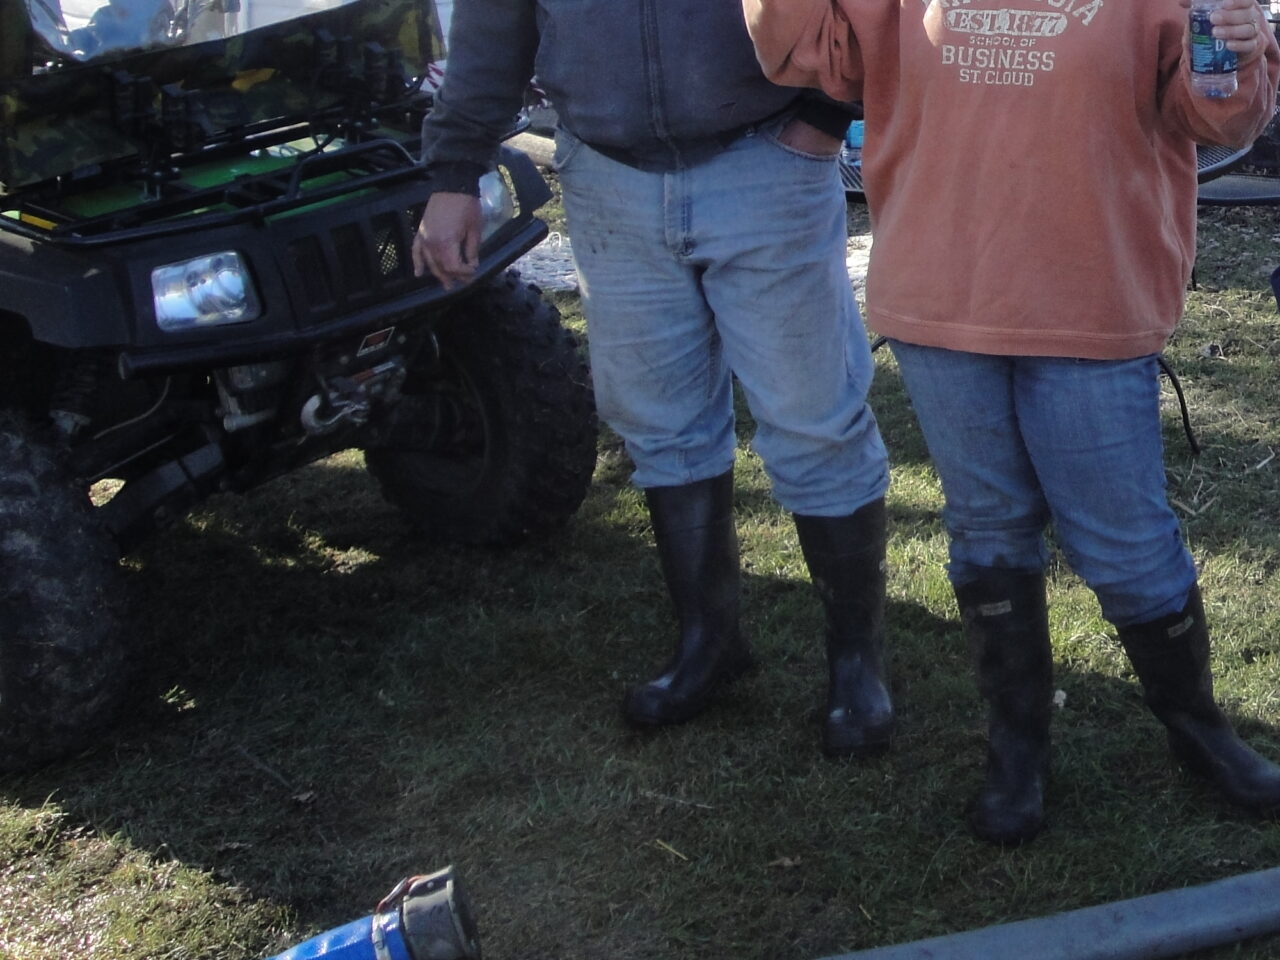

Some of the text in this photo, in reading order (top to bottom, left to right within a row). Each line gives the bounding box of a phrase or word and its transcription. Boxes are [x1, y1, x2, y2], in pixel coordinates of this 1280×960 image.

[969, 36, 1036, 48] SCHOOL OF
[942, 45, 1056, 71] BUSINESS
[959, 69, 1034, 86] ST. CLOUD
